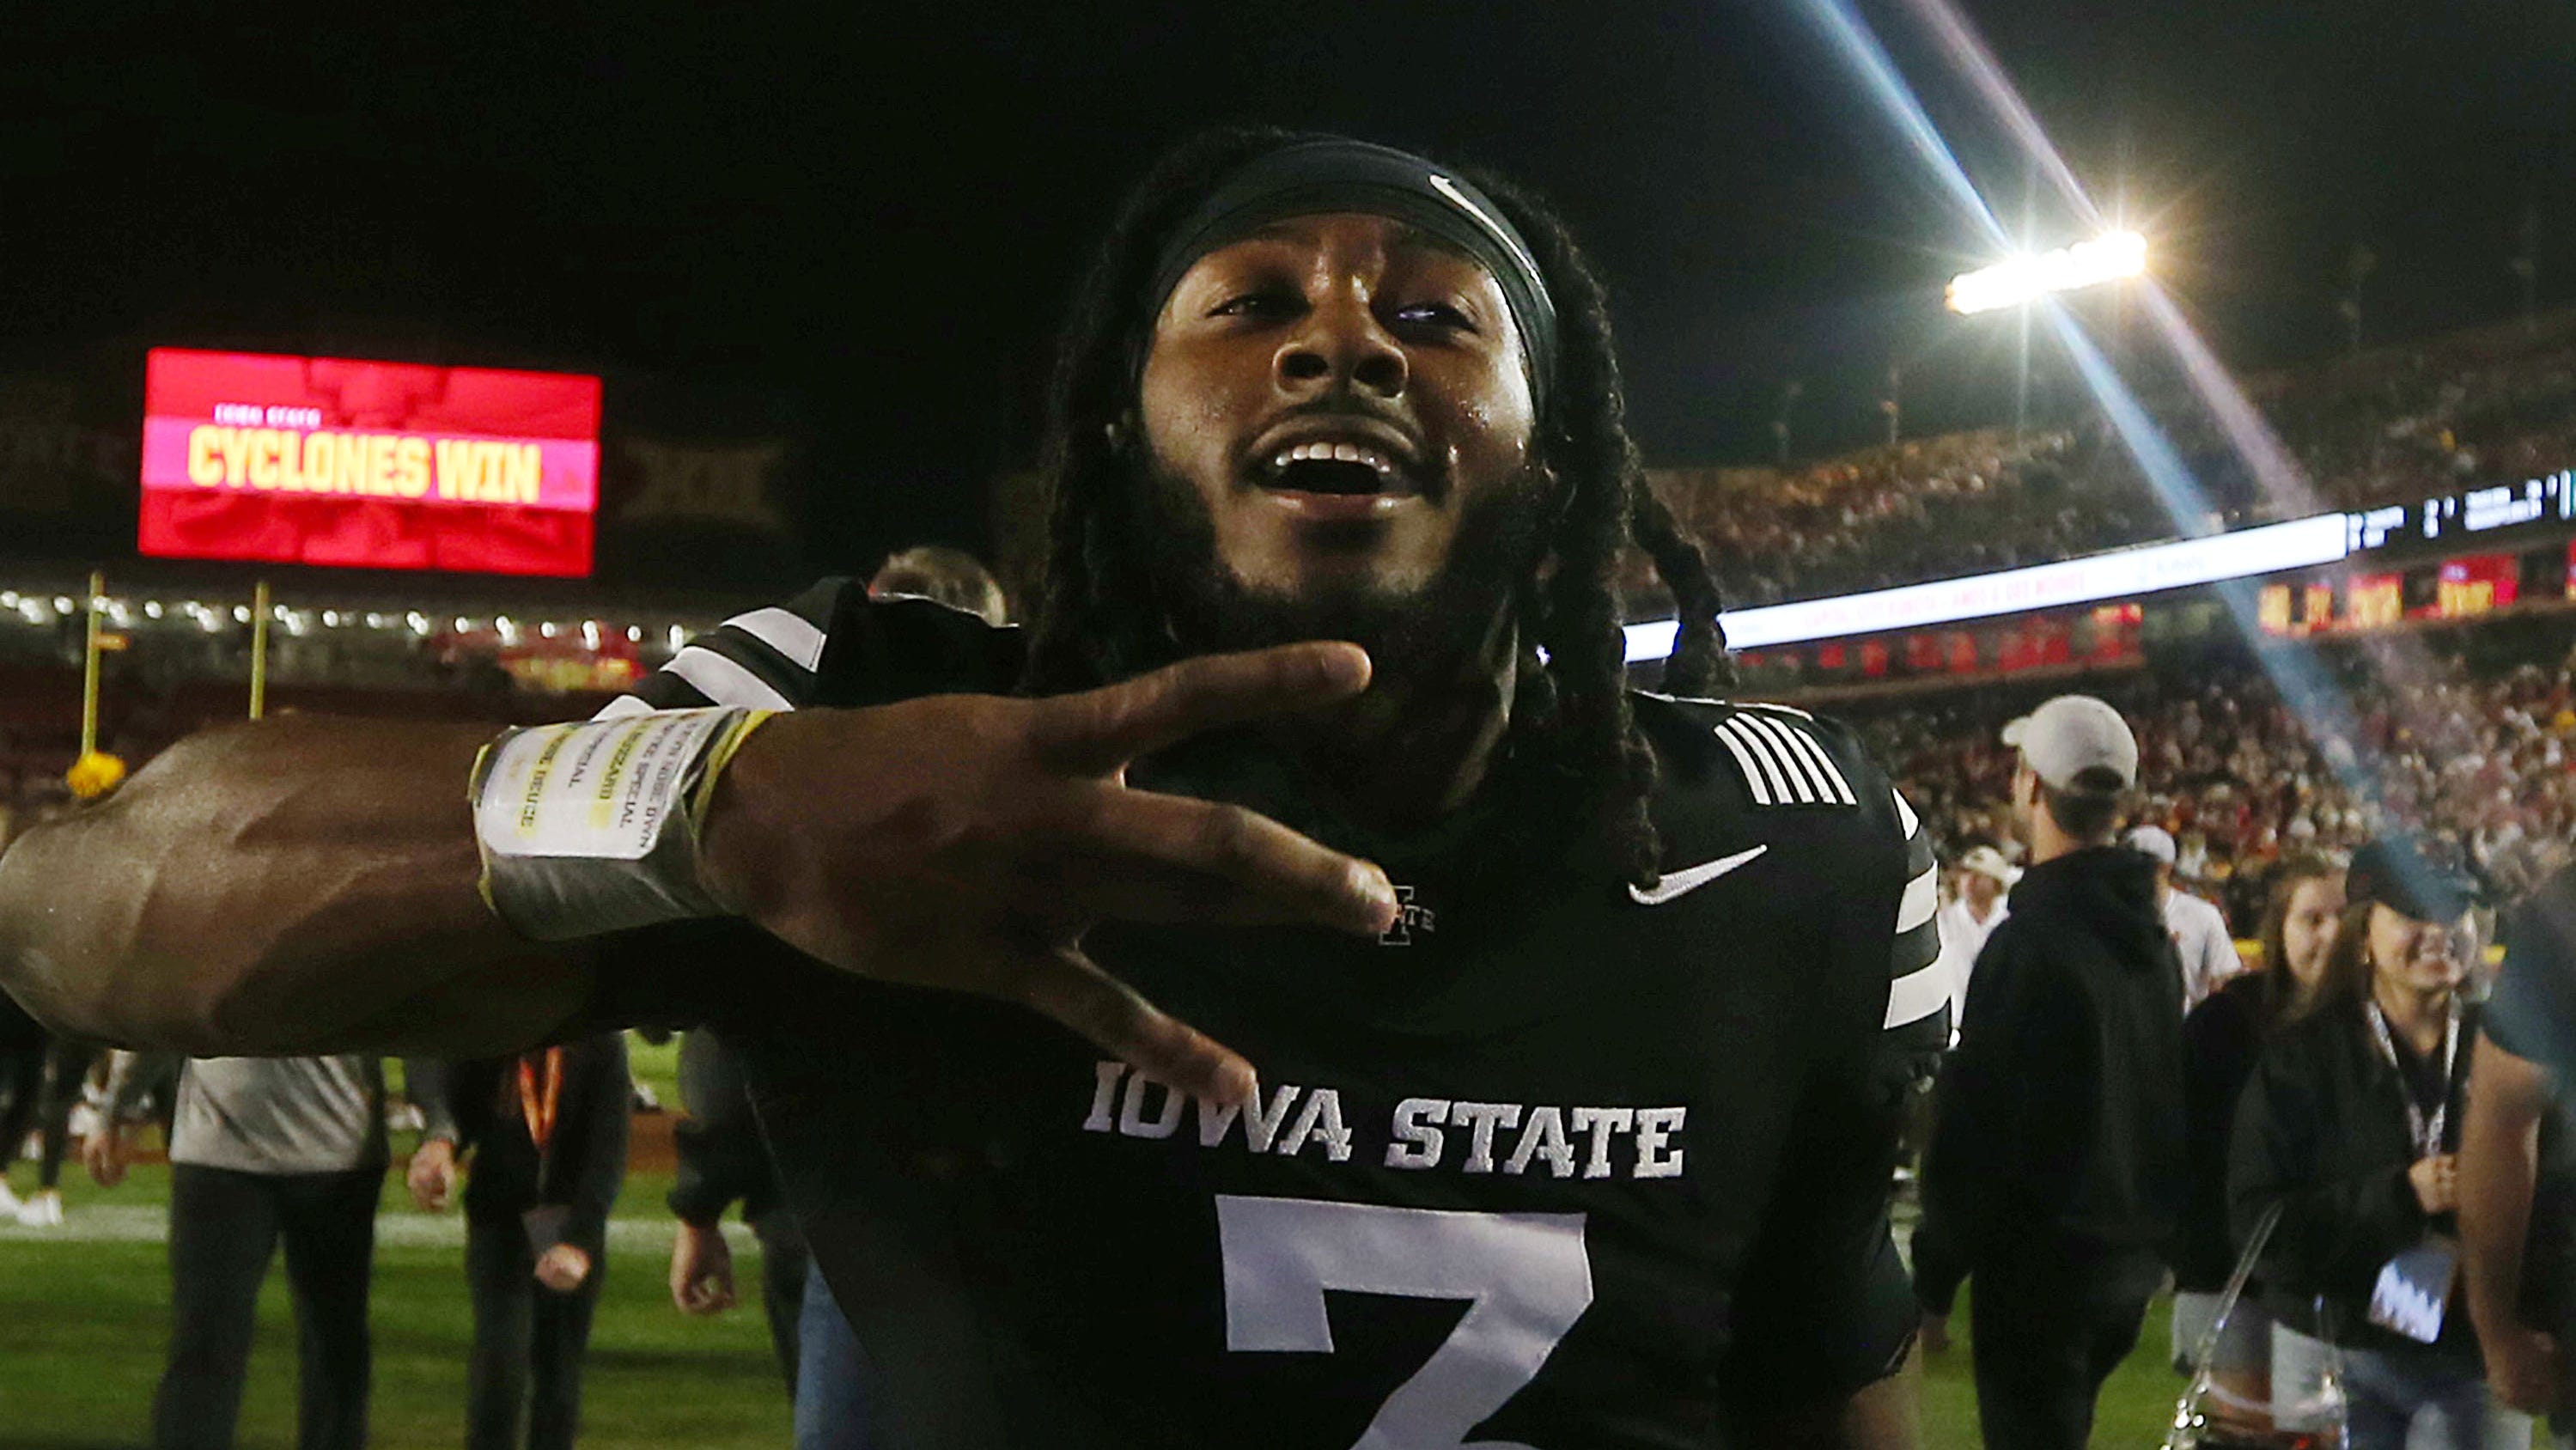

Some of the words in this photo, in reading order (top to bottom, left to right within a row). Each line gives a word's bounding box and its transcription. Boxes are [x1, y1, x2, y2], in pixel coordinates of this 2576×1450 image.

[188, 425, 431, 498] CYCLONES
[435, 437, 542, 503] WIN
[1081, 1061, 1353, 1162] IOWA
[1382, 1096, 1688, 1179] STATE
